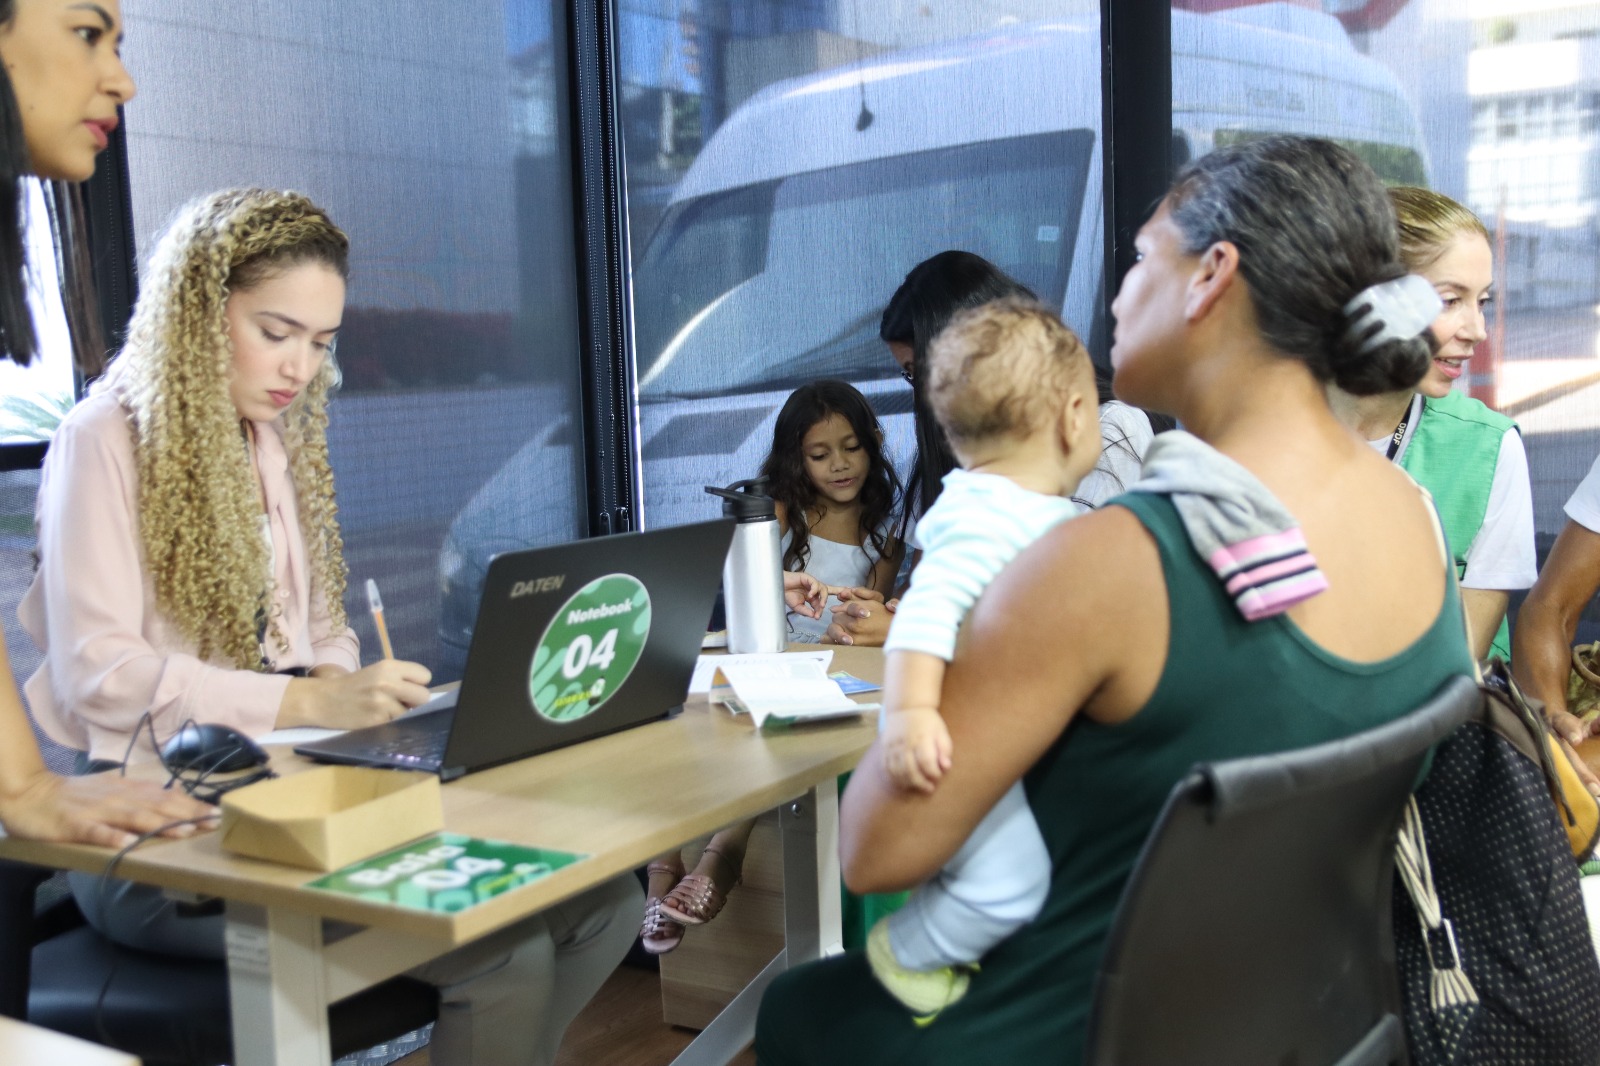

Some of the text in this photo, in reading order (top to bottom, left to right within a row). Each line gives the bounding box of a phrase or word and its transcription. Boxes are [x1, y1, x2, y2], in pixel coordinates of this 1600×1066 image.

[510, 575, 565, 598] DATEN
[567, 598, 632, 625] Notebook
[562, 628, 619, 679] 04
[347, 846, 467, 887] Baia
[411, 856, 506, 889] 04
